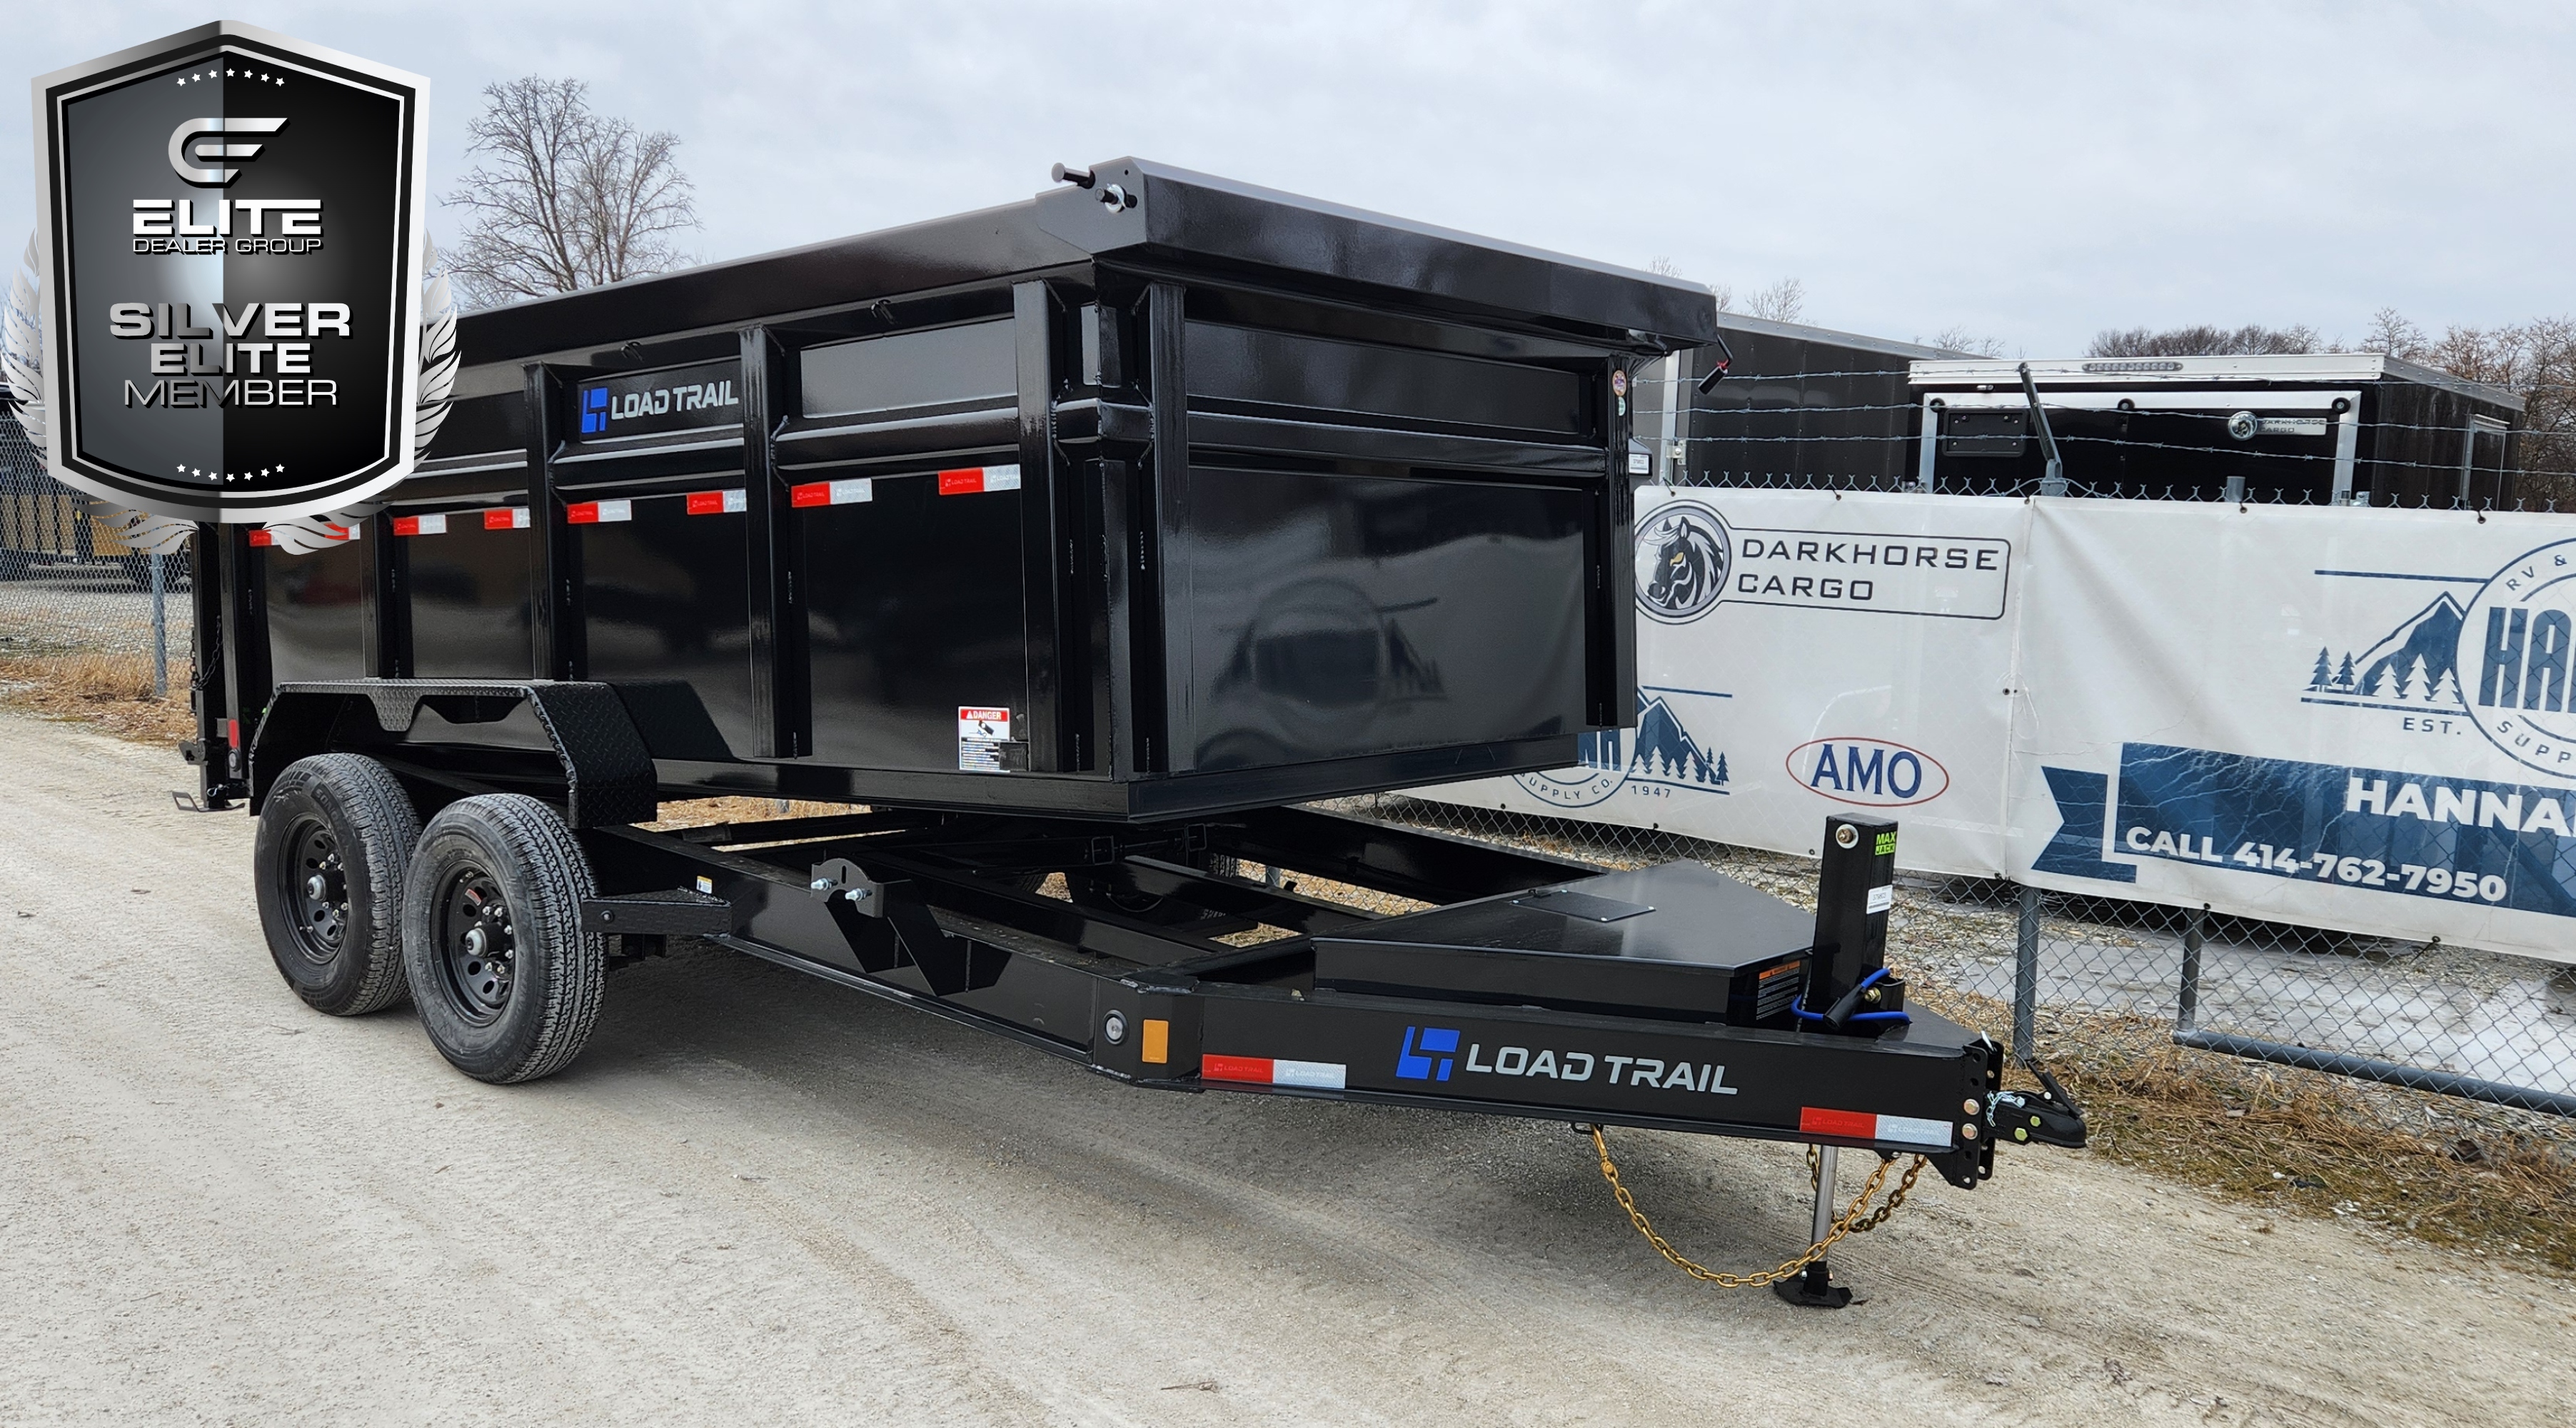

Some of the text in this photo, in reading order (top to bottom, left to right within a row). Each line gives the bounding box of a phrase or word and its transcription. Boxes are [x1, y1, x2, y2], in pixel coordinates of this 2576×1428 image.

[611, 380, 739, 420] LOAD TRAIL
[1742, 538, 1999, 570] DARKHORSE
[1738, 573, 1873, 600] CARGO
[2505, 554, 2567, 591] RV &
[2478, 606, 2576, 713] HA
[972, 710, 1002, 720] DANGER
[2403, 716, 2461, 735] EST.
[1591, 778, 1614, 795] CO.
[1810, 743, 1922, 799] AMO
[1631, 785, 1671, 798] 1947
[2346, 776, 2576, 838] HANNA
[1876, 831, 1897, 845] MAX
[1876, 844, 1894, 854] JACK
[2125, 826, 2507, 902] CALL 414-762-7950
[1465, 1043, 1739, 1095] LOAD TRAIL
